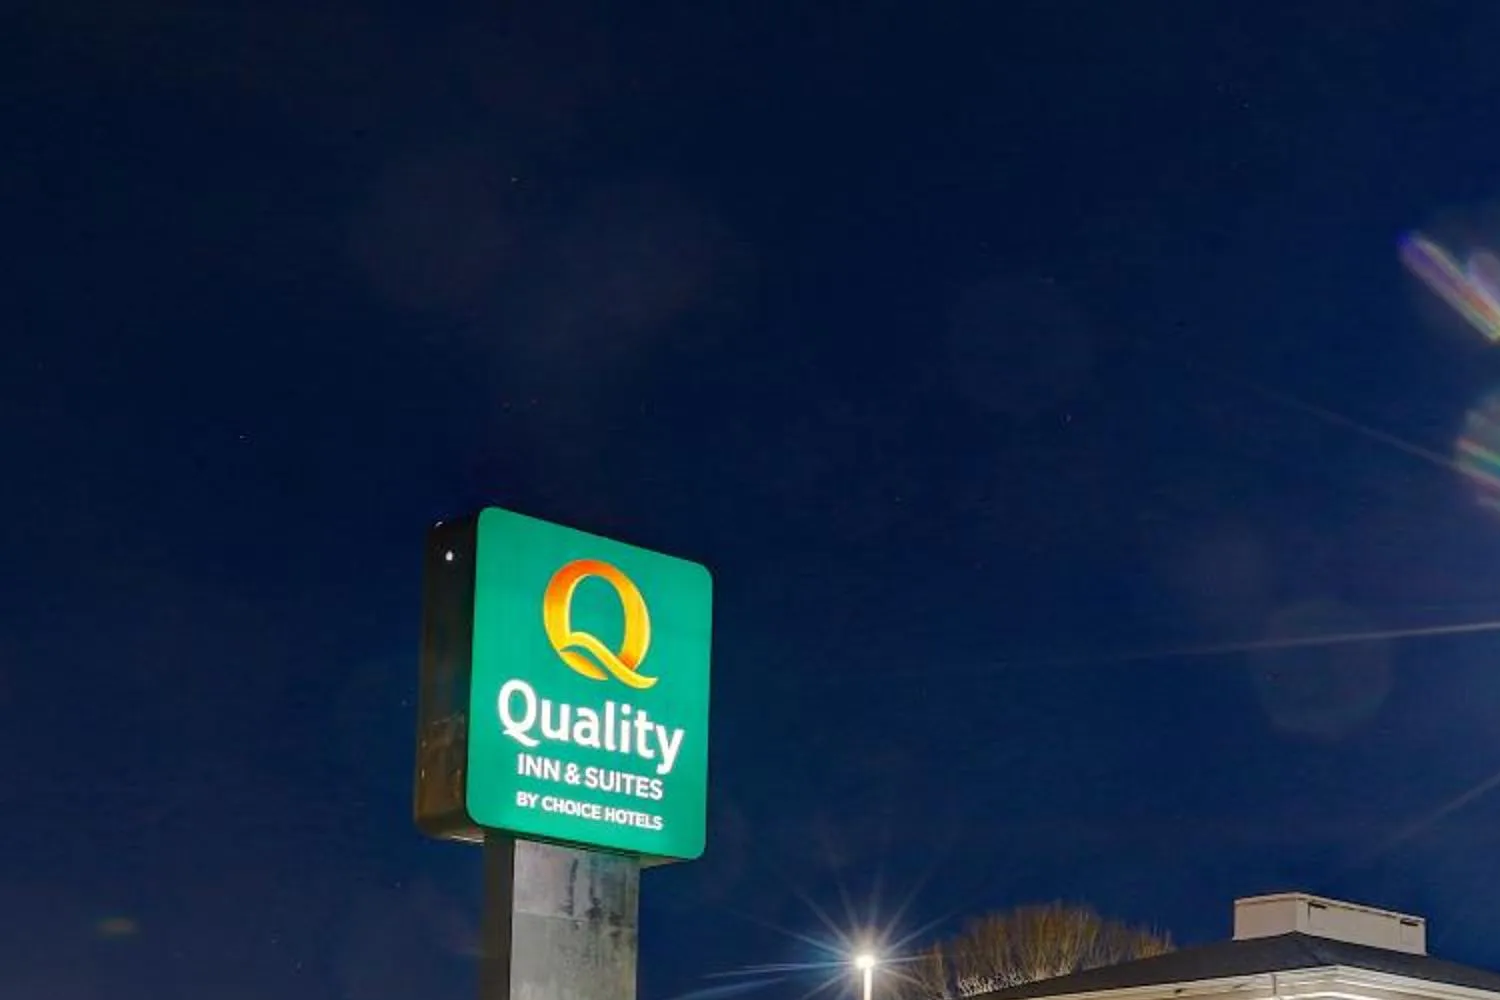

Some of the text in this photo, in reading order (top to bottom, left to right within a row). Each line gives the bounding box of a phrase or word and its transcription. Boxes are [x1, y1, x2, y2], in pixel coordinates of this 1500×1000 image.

[543, 558, 658, 689] Q
[498, 679, 685, 775] Quality
[516, 791, 663, 830] BY CHOICE HOTELS
[517, 753, 663, 800] INN & SUITES
